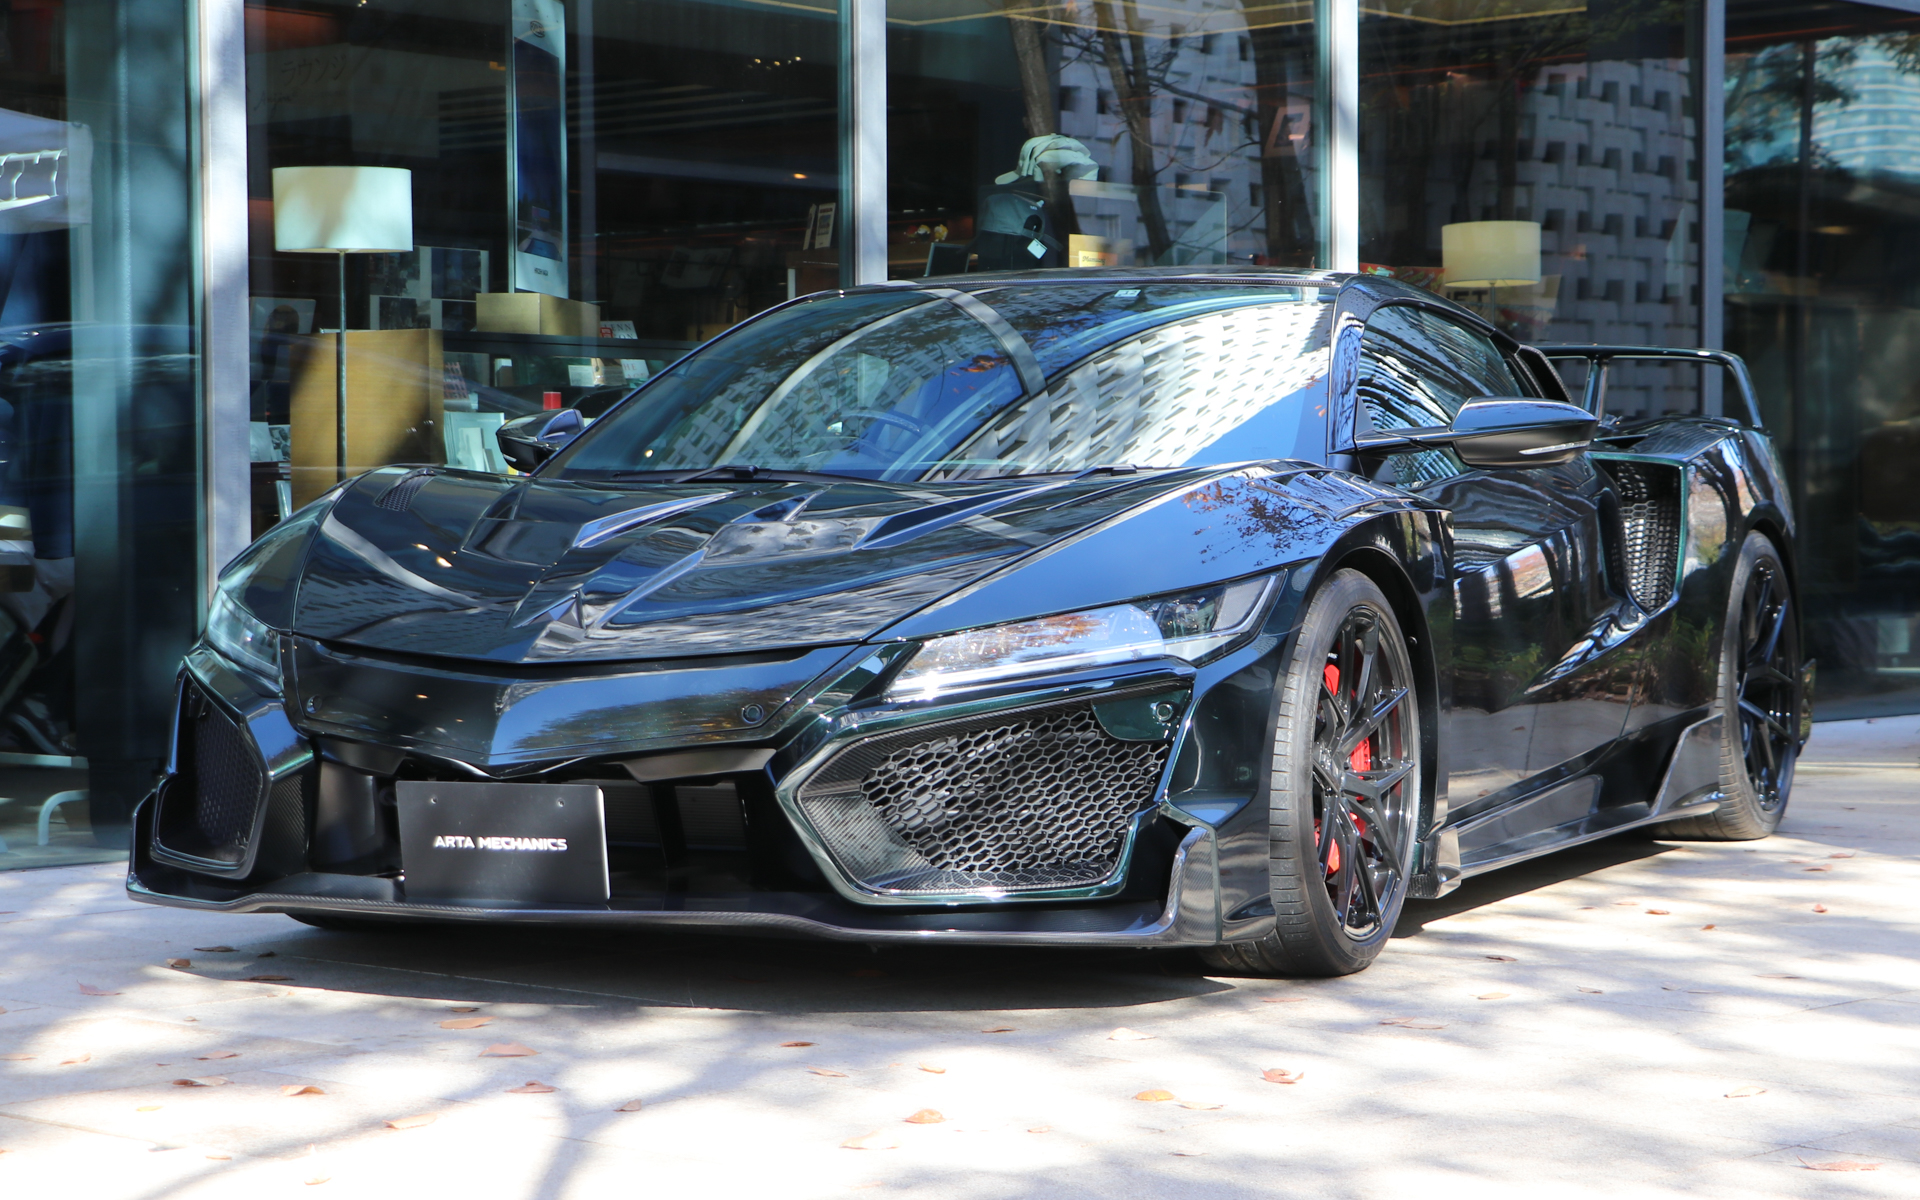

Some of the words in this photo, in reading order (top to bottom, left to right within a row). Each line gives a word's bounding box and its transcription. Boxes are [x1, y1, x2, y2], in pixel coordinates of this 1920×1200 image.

[280, 53, 347, 87] ラウンジ
[433, 835, 475, 848] ARTA
[477, 836, 568, 851] MECHANICS
